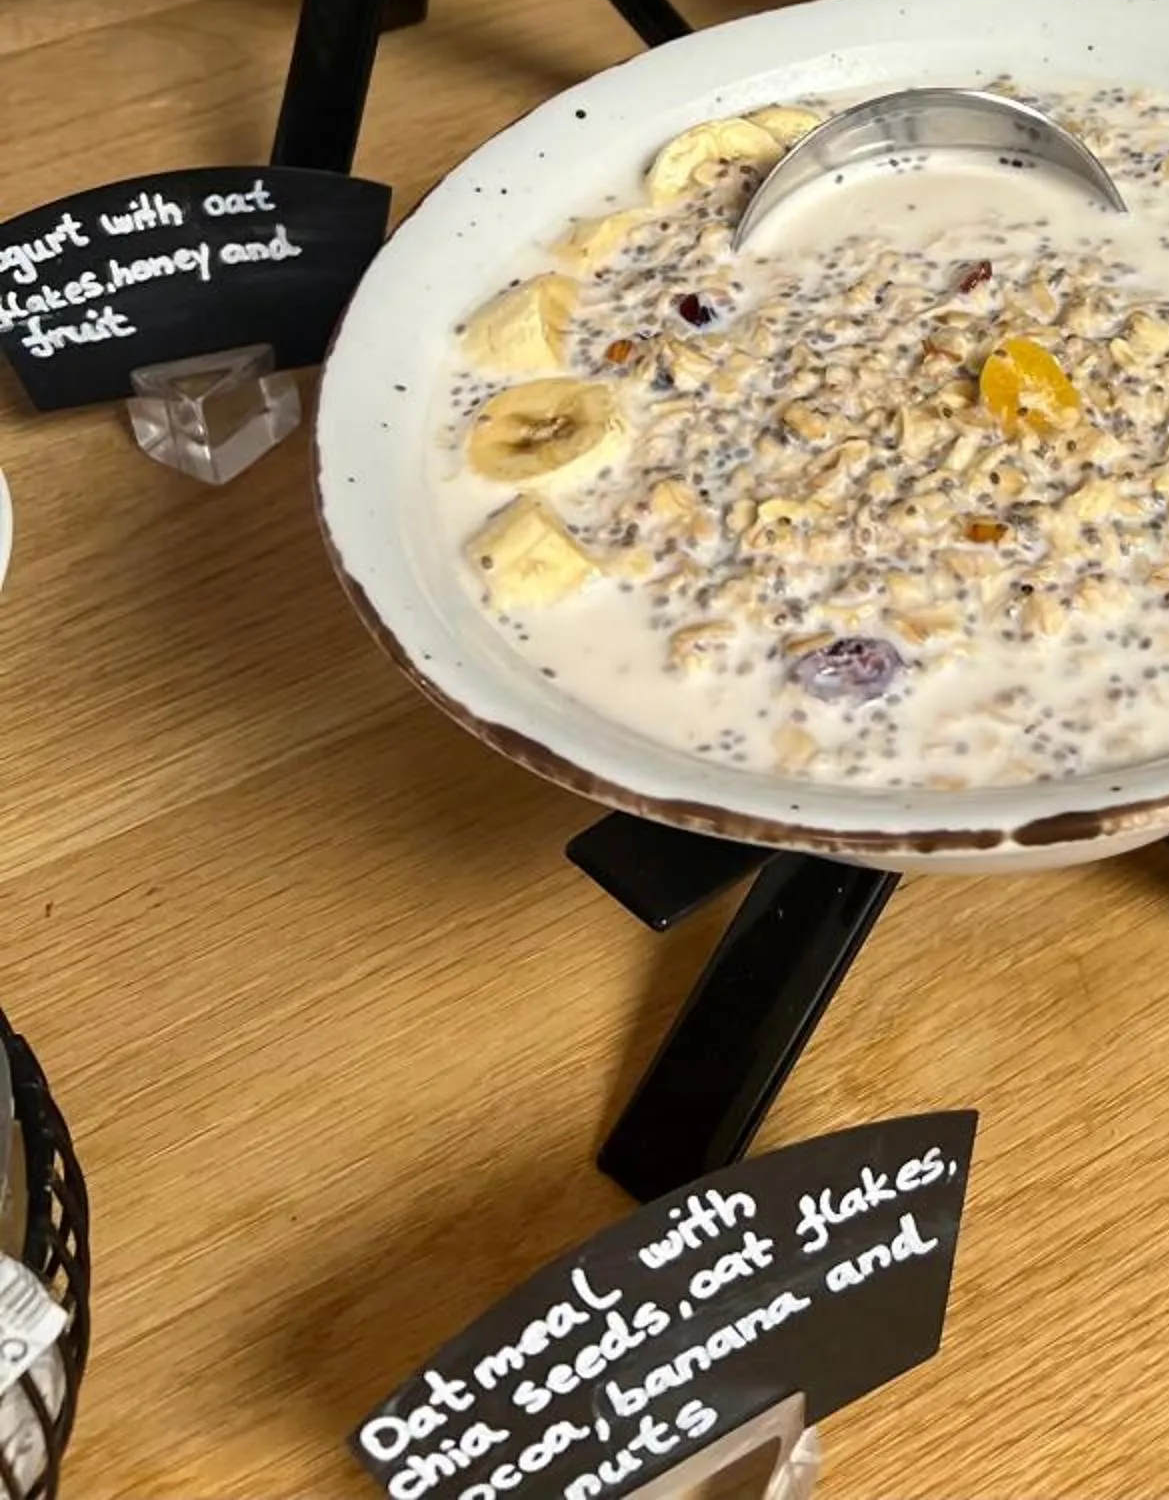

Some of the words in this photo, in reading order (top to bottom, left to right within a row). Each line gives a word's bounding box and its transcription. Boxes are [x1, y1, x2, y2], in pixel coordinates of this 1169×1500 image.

[100, 192, 184, 235] with
[203, 179, 276, 216] oat
[219, 224, 302, 264] and
[21, 305, 137, 358] fruit
[638, 1189, 757, 1269] with
[825, 1213, 939, 1293] and
[387, 1422, 510, 1500] chia
[795, 1147, 957, 1254] flakes,
[563, 1399, 718, 1500] nuts
